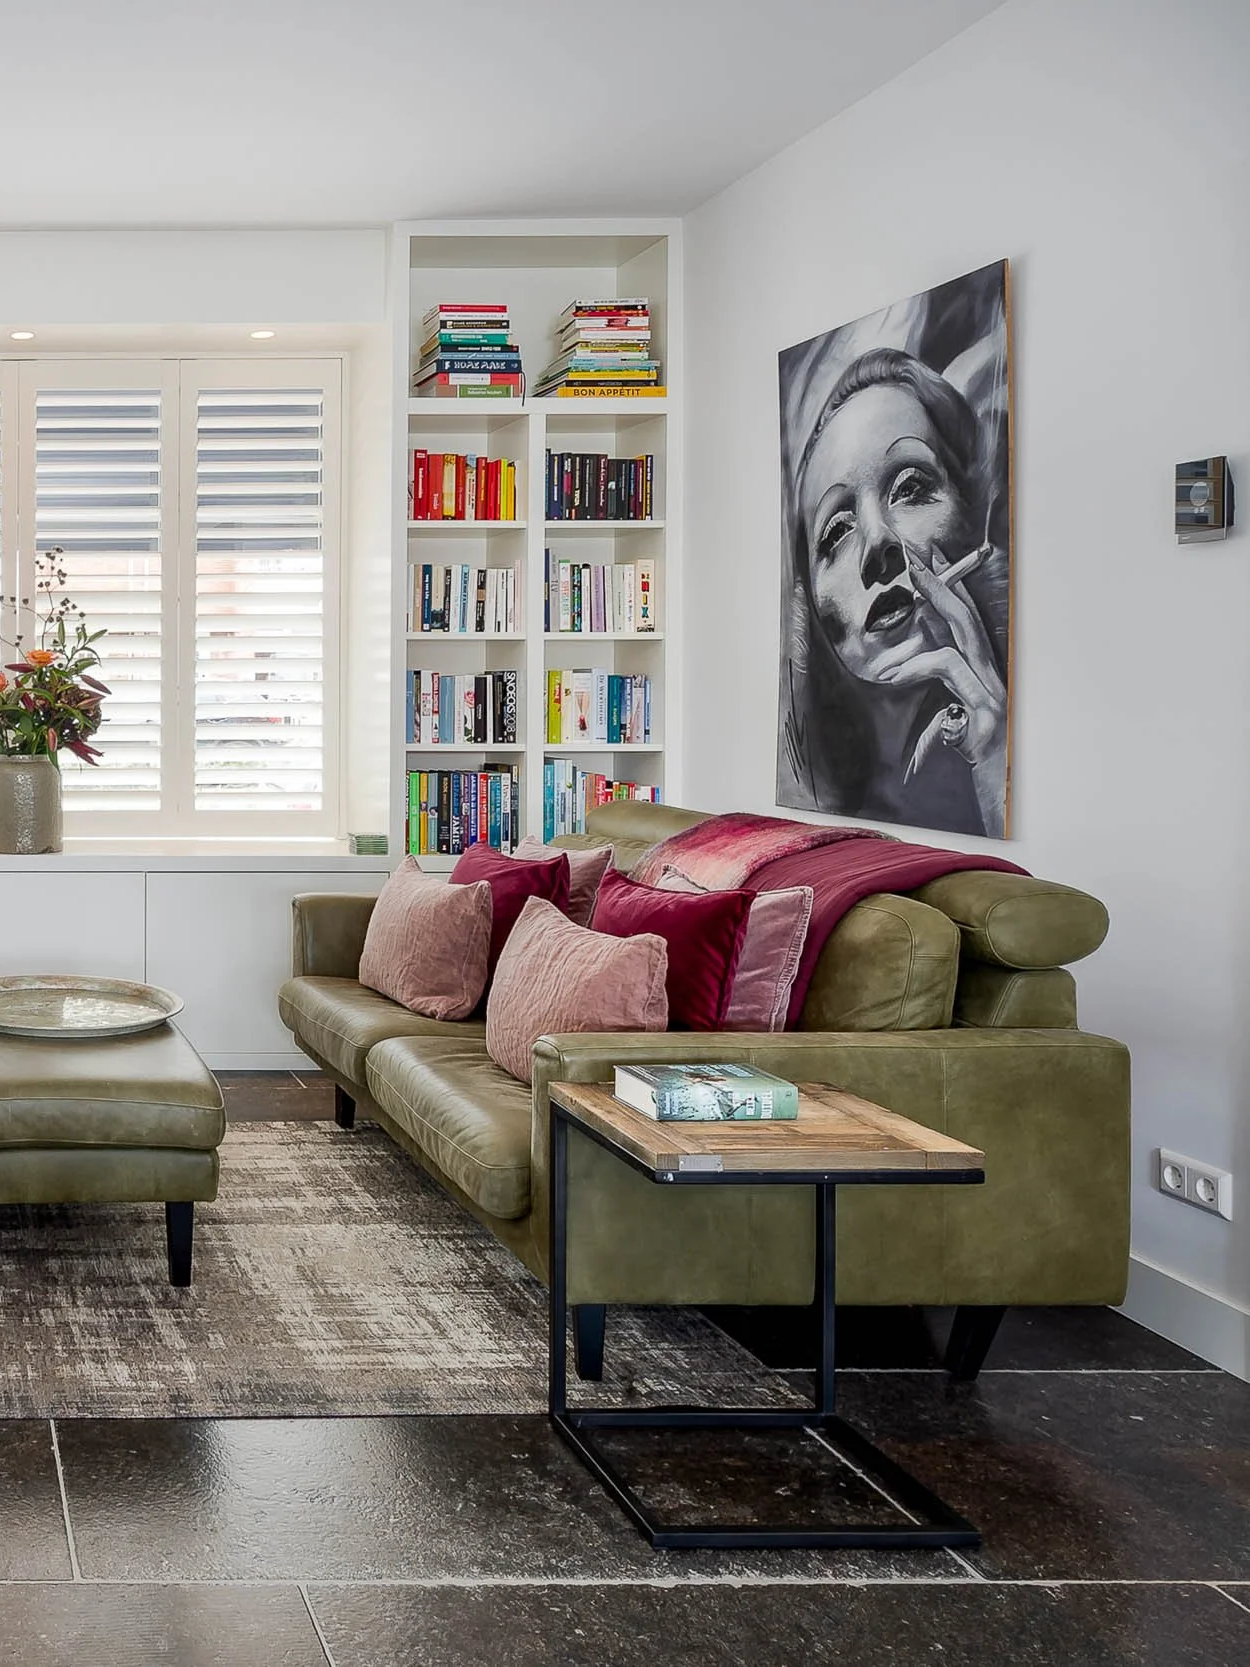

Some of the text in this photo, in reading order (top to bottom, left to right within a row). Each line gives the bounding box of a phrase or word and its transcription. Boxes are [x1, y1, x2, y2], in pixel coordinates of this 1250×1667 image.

[573, 386, 641, 396] BON APPÉTIT
[551, 579, 559, 593] TLV
[506, 672, 516, 732] SNOECKS 2018
[452, 815, 460, 844] JAMIE
